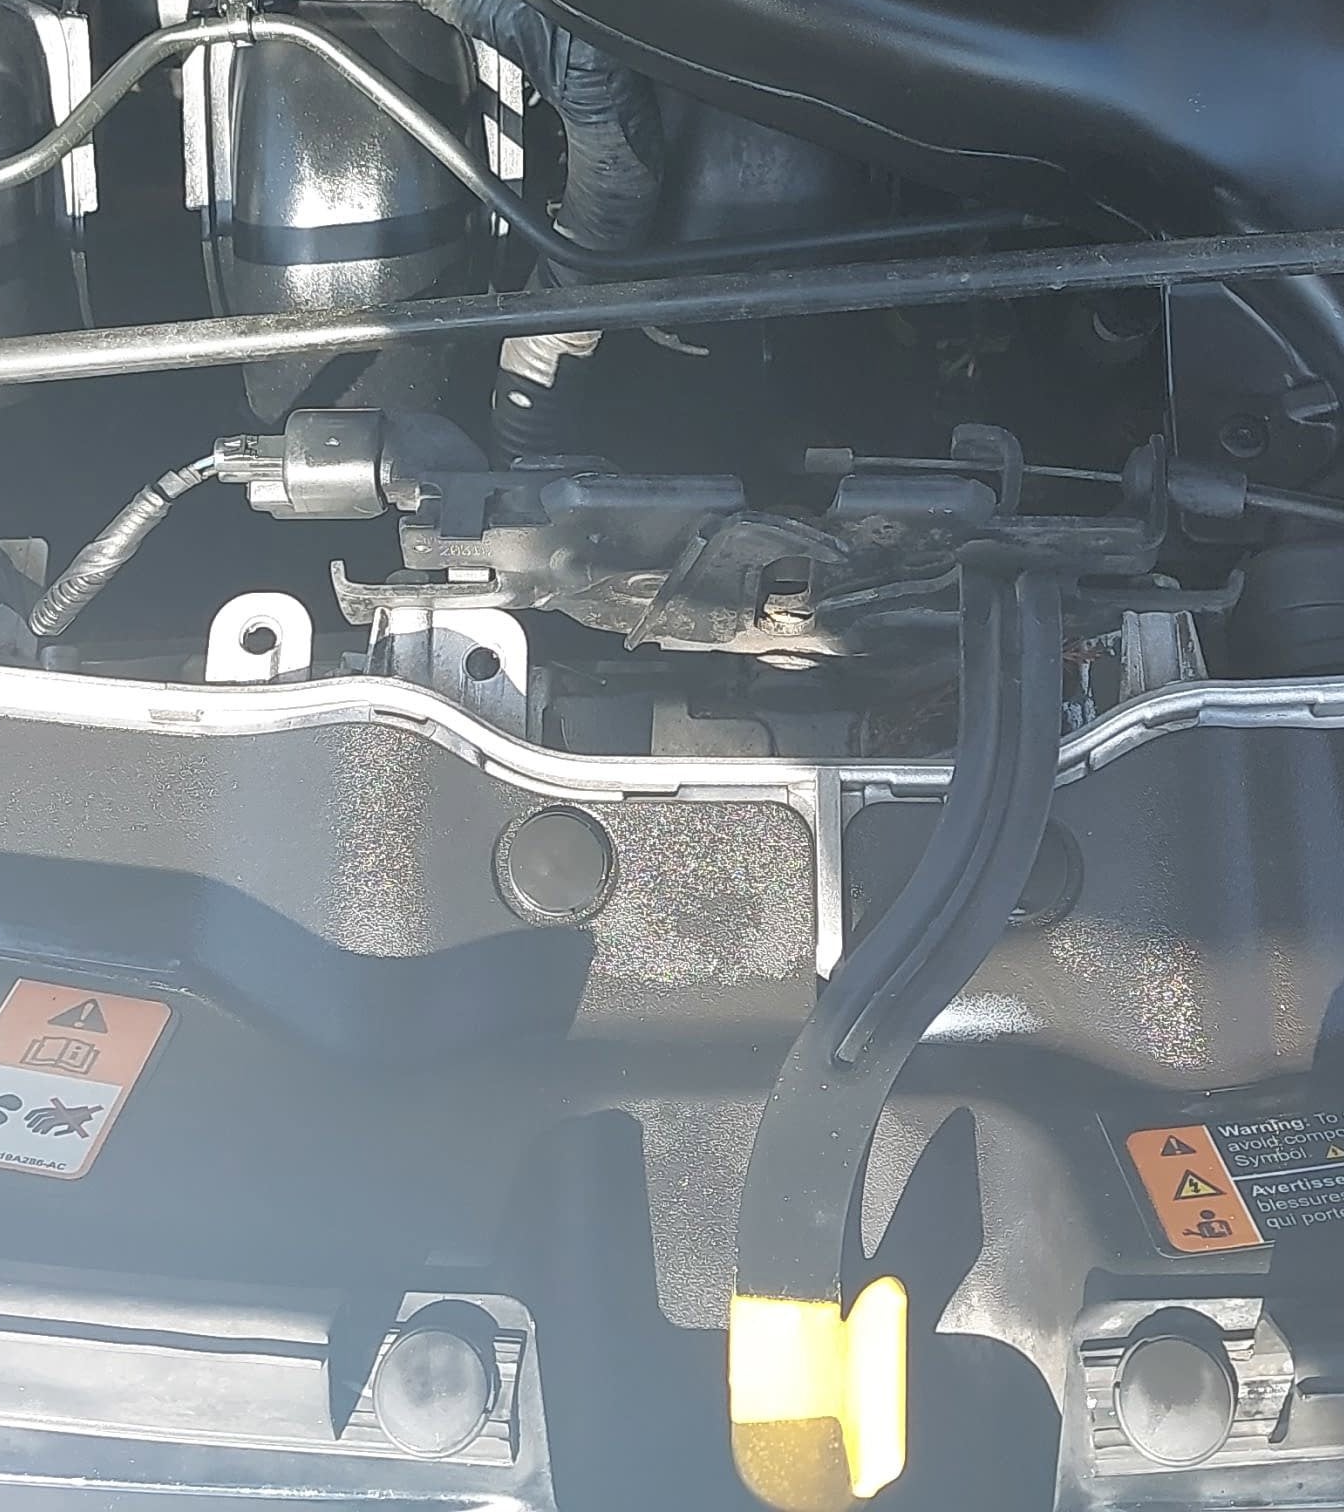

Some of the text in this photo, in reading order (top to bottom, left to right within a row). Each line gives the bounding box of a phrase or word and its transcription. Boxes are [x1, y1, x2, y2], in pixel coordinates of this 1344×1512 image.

[1218, 1118, 1311, 1138] Warning:
[1314, 1113, 1338, 1125] To
[1228, 1135, 1279, 1153] avoid
[1235, 1147, 1312, 1168] Symbol.
[1266, 1212, 1298, 1231] qui
